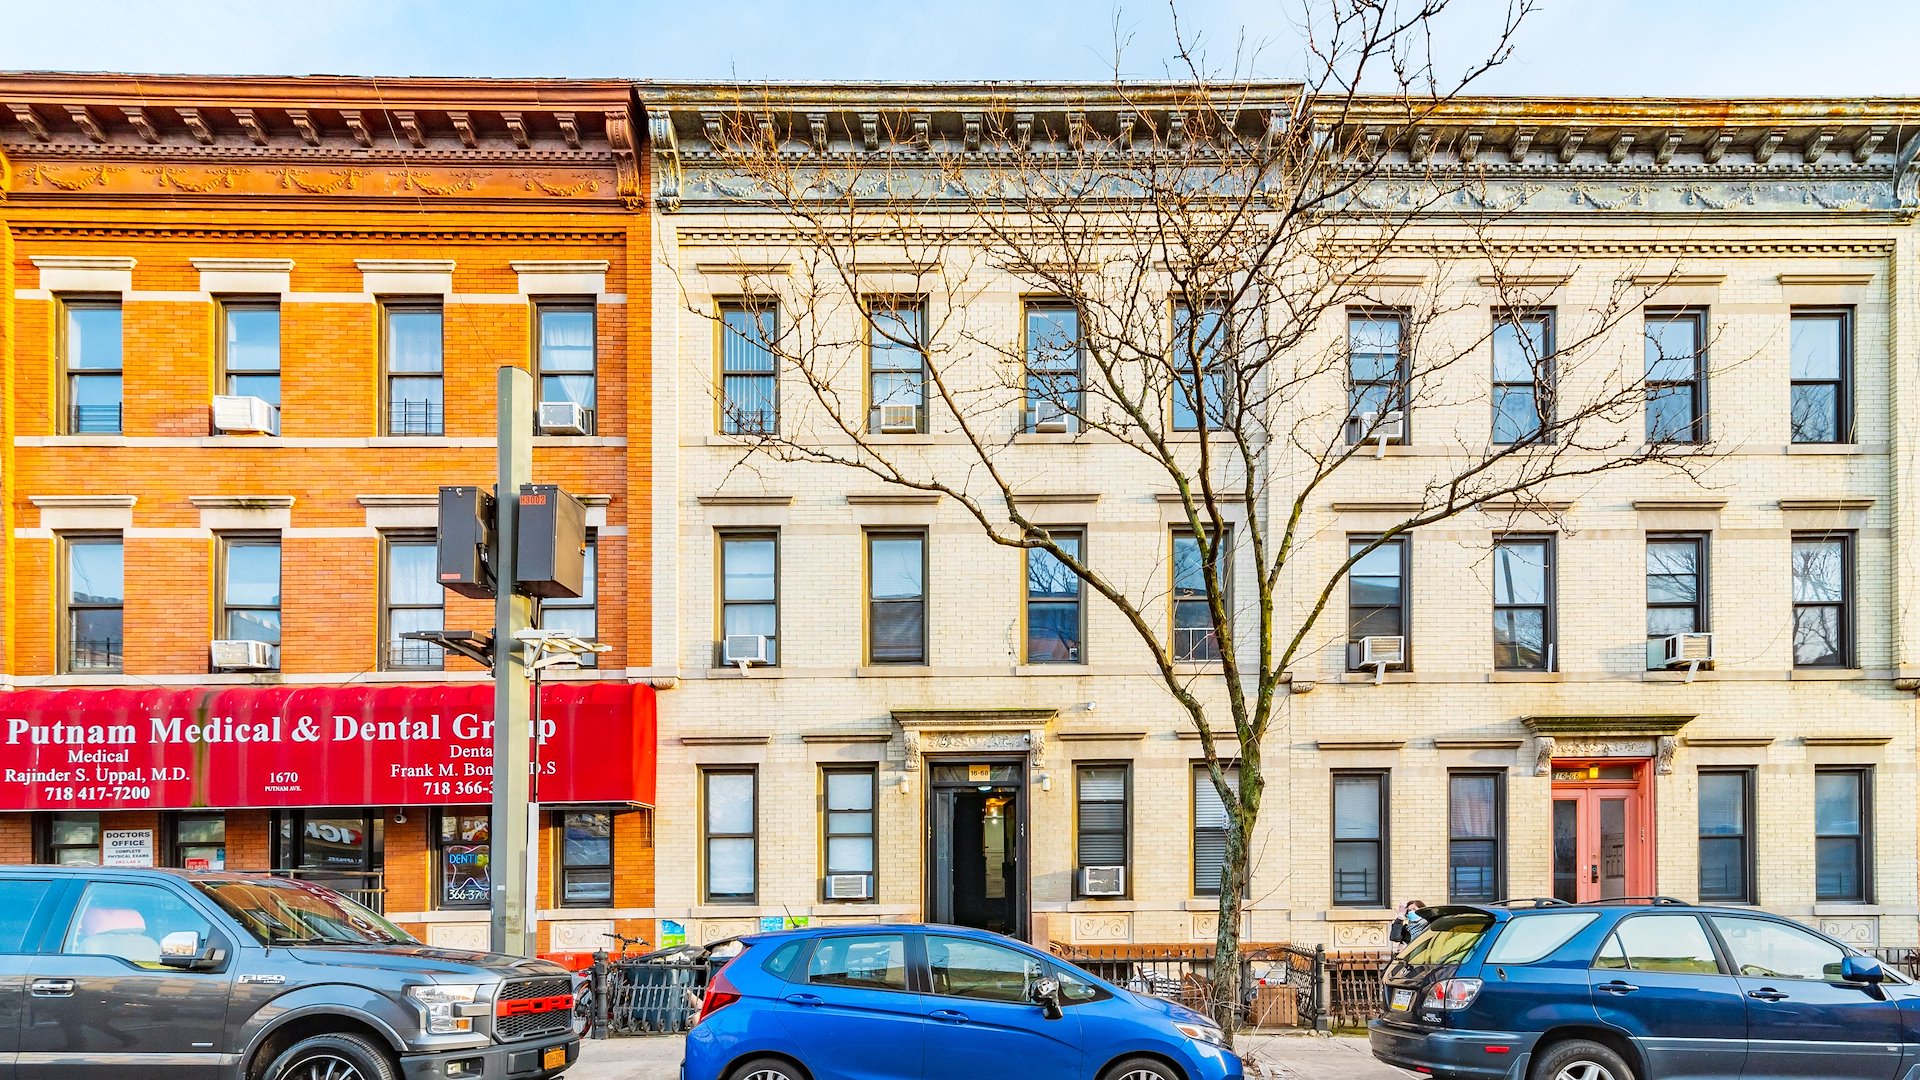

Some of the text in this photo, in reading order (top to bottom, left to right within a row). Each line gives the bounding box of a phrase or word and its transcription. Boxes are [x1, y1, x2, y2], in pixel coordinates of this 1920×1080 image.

[6, 713, 556, 745] Putnam Medical & Dental Grp
[67, 749, 129, 763] Medical
[449, 744, 494, 758] Denta
[4, 767, 190, 785] Rajinder S. Uppal, M.D.
[390, 763, 434, 777] Frank
[438, 763, 459, 777] M.
[269, 772, 299, 784] 1670
[44, 786, 150, 800] 718 417-7200
[423, 782, 451, 795] 718
